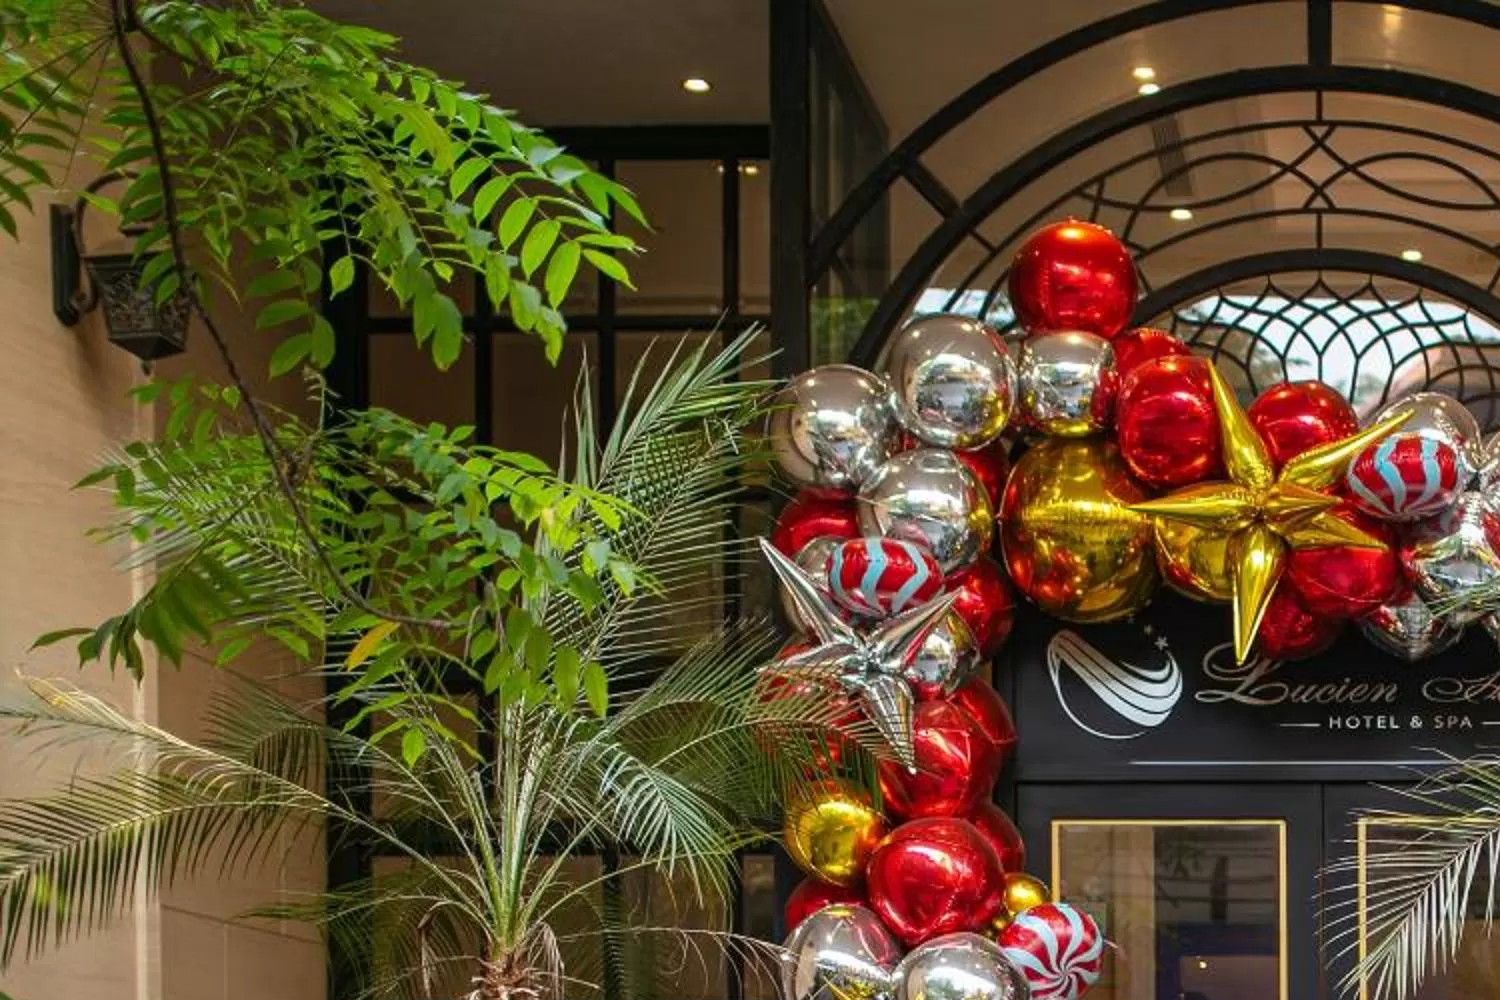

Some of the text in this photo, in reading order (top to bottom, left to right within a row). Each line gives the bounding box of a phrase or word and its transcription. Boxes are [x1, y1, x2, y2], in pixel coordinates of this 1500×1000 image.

[1195, 642, 1398, 705] Lucien
[1328, 714, 1473, 729] HOTEL & SPA
